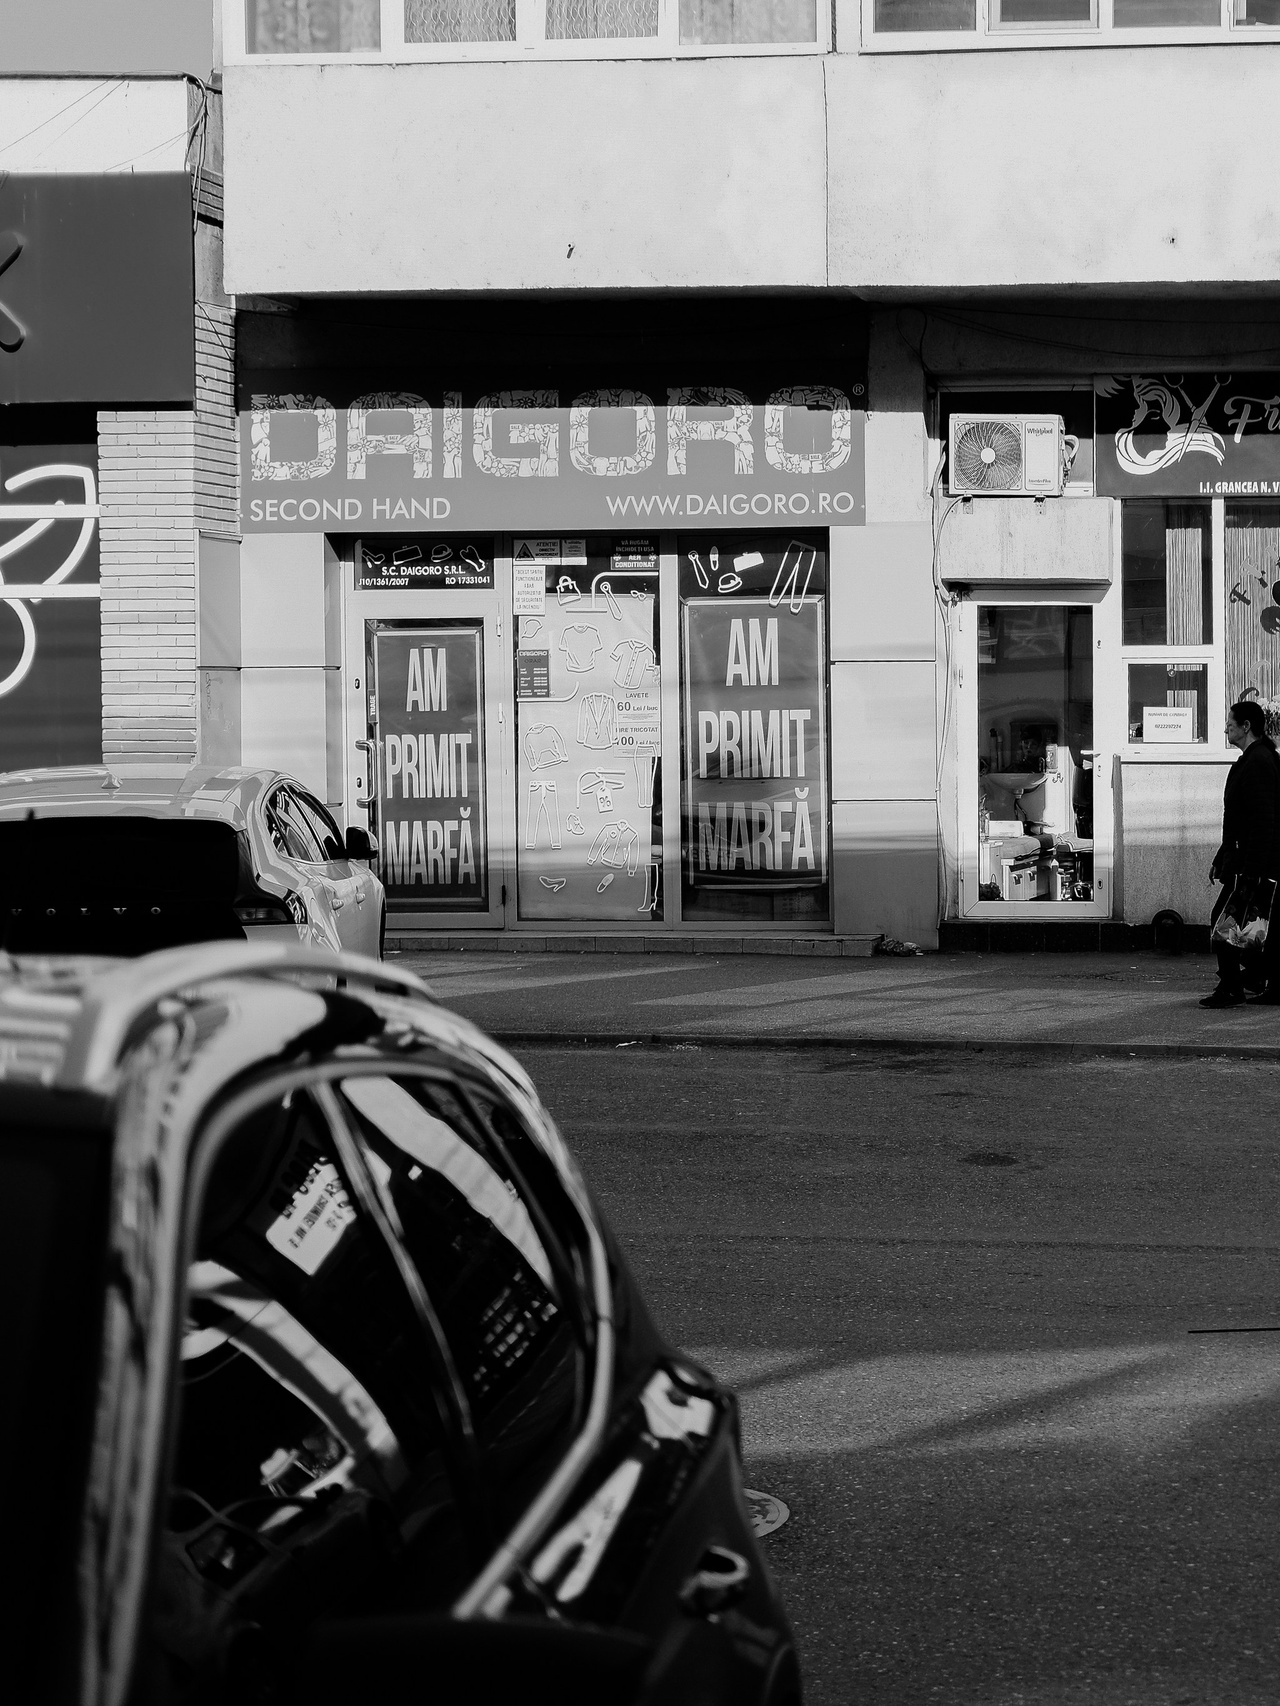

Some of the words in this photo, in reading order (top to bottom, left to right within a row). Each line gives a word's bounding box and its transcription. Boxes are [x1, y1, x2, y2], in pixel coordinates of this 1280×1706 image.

[251, 386, 851, 481] DAIGORO
[1027, 427, 1053, 437] Whirlpool
[1215, 481, 1259, 493] GRANCEA
[1260, 481, 1271, 493] N.
[250, 498, 362, 522] SECOND
[372, 497, 451, 520] HAND
[605, 492, 854, 516] WWW.DAIGORO.RO
[382, 567, 398, 575] S.C.
[400, 566, 442, 575] DAIGORO
[444, 565, 466, 574] S.R.L.
[458, 576, 490, 584] 17331041
[726, 618, 779, 686] AM
[406, 648, 447, 712] AM
[617, 701, 631, 711] 60
[698, 709, 811, 779] PRIMIT
[385, 733, 472, 799] PRIMIT
[698, 787, 816, 871] MARFĂ
[386, 806, 476, 885] MARFĂ
[11, 906, 162, 916] VOLVO
